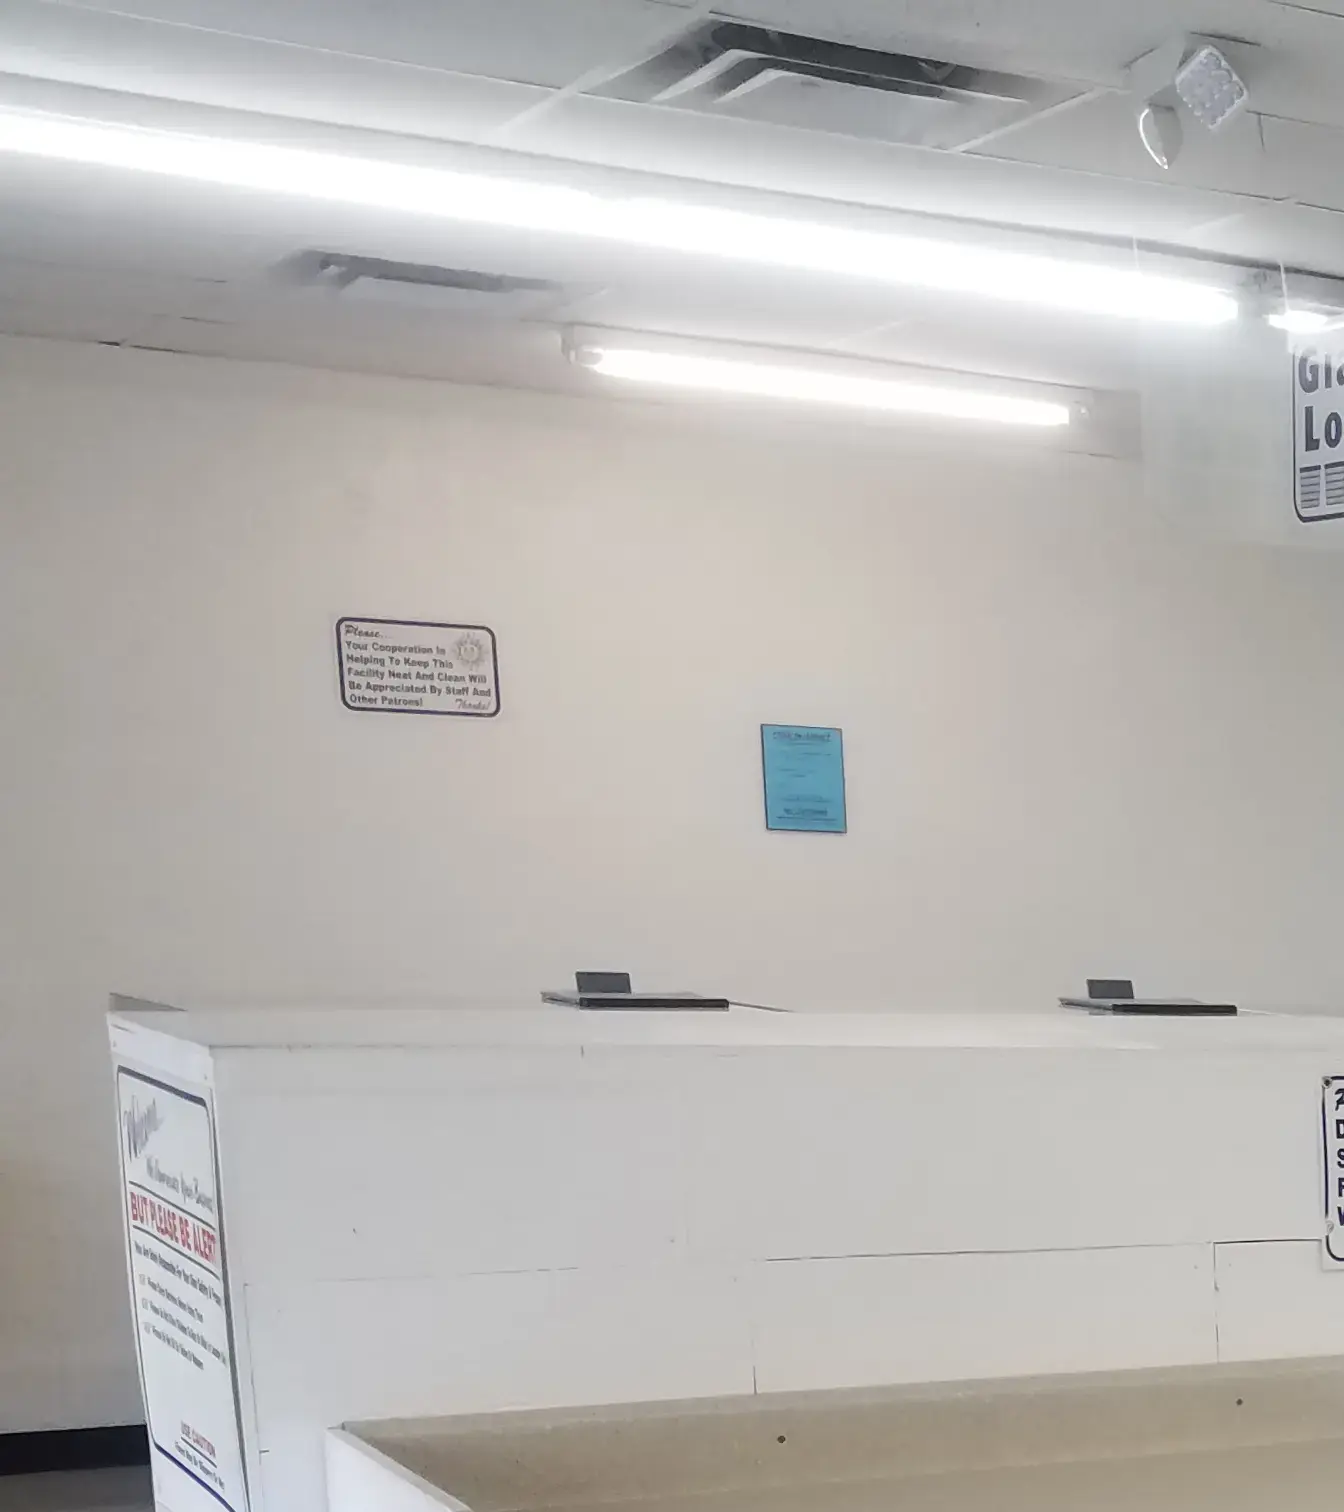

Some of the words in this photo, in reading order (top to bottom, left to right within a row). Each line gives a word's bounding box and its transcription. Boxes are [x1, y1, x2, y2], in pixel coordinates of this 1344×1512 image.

[346, 641, 368, 650] Your
[372, 642, 433, 654] Cooperation
[436, 646, 446, 655] In
[346, 654, 385, 666] Helping
[389, 656, 400, 665] To
[404, 657, 429, 668] Keep
[433, 659, 453, 669] This
[348, 668, 385, 680] Facility
[388, 670, 412, 679] Neat
[415, 672, 434, 681] And
[438, 673, 466, 682] Clean
[469, 674, 487, 683] Will
[349, 681, 362, 690] Be
[366, 682, 427, 694] Appreciated
[430, 685, 442, 696] By
[445, 686, 469, 695] Staff
[472, 688, 491, 697] And
[350, 694, 377, 704] Other
[130, 1192, 148, 1226] BUT
[149, 1199, 179, 1244] PLEASE
[179, 1215, 192, 1251] BE
[192, 1222, 216, 1263] ALERT
